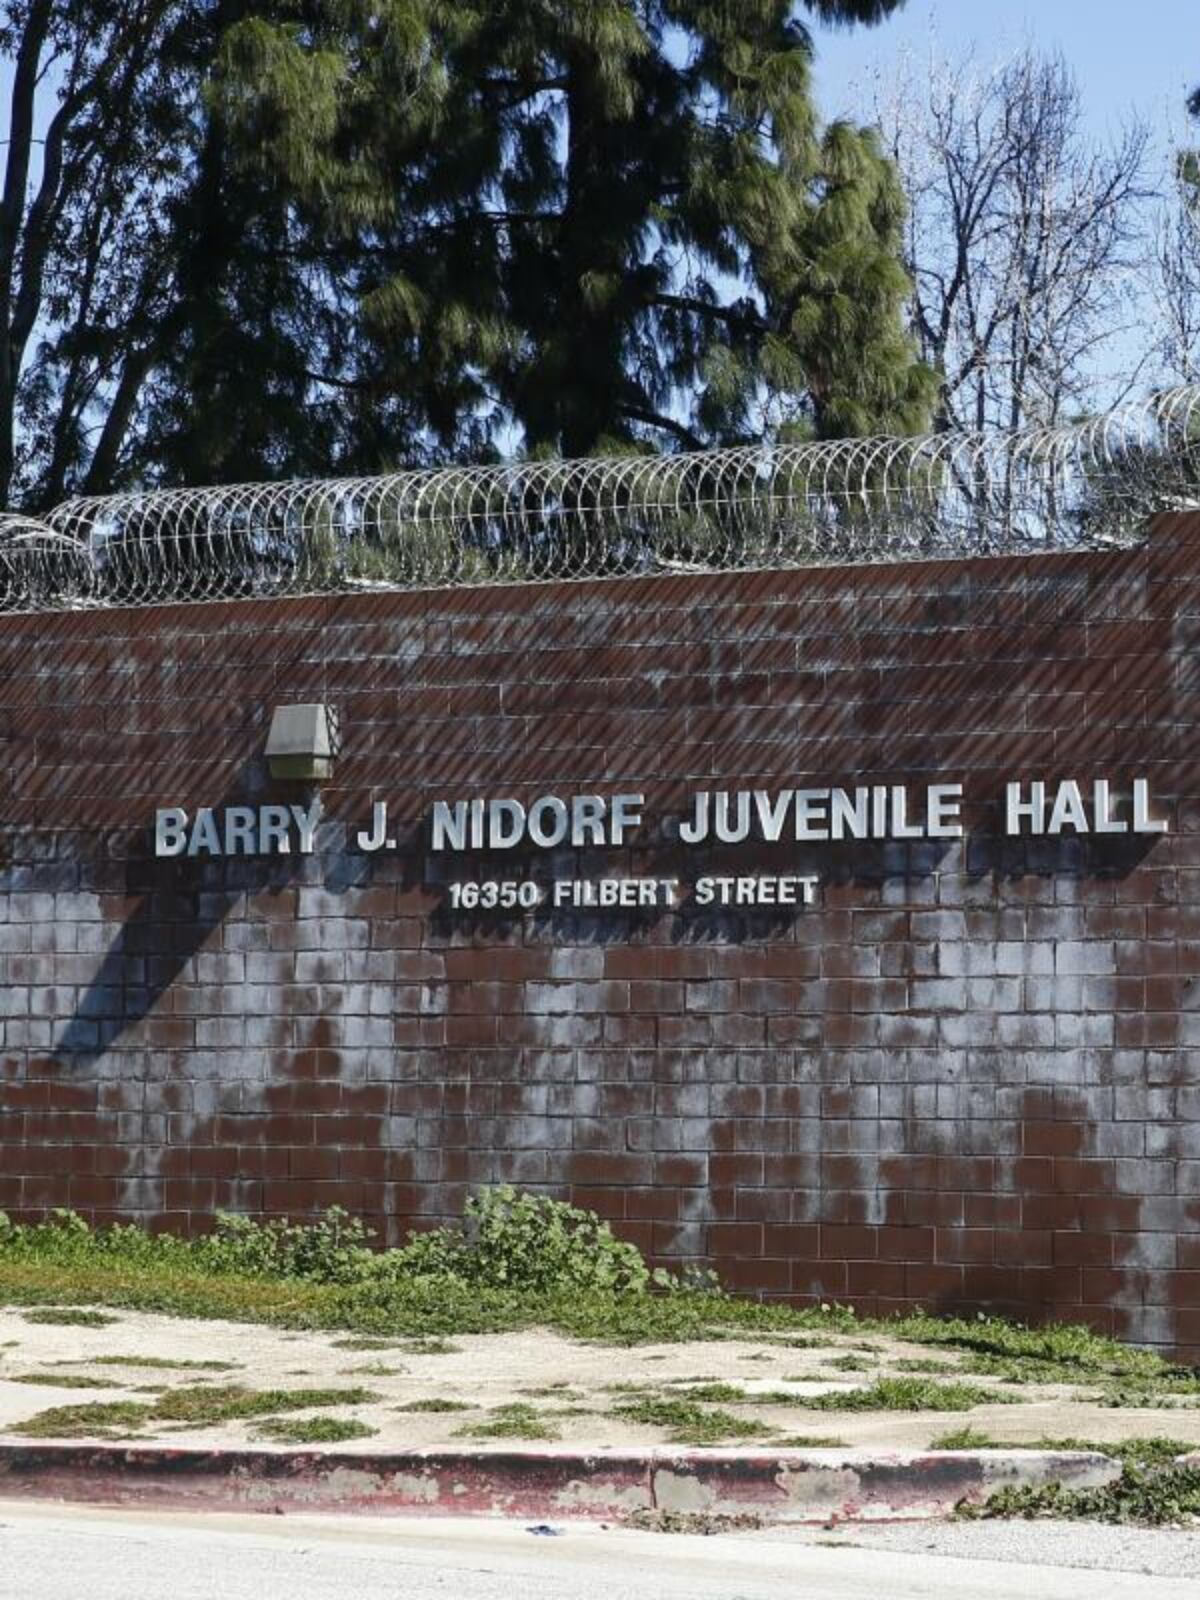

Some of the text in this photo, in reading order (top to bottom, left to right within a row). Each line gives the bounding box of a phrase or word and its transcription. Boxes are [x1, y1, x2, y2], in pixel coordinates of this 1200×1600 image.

[155, 778, 1169, 857] BARRY J. NIDORF JUVENILE HALL
[449, 875, 819, 909] 16350 FILBERT STREET
